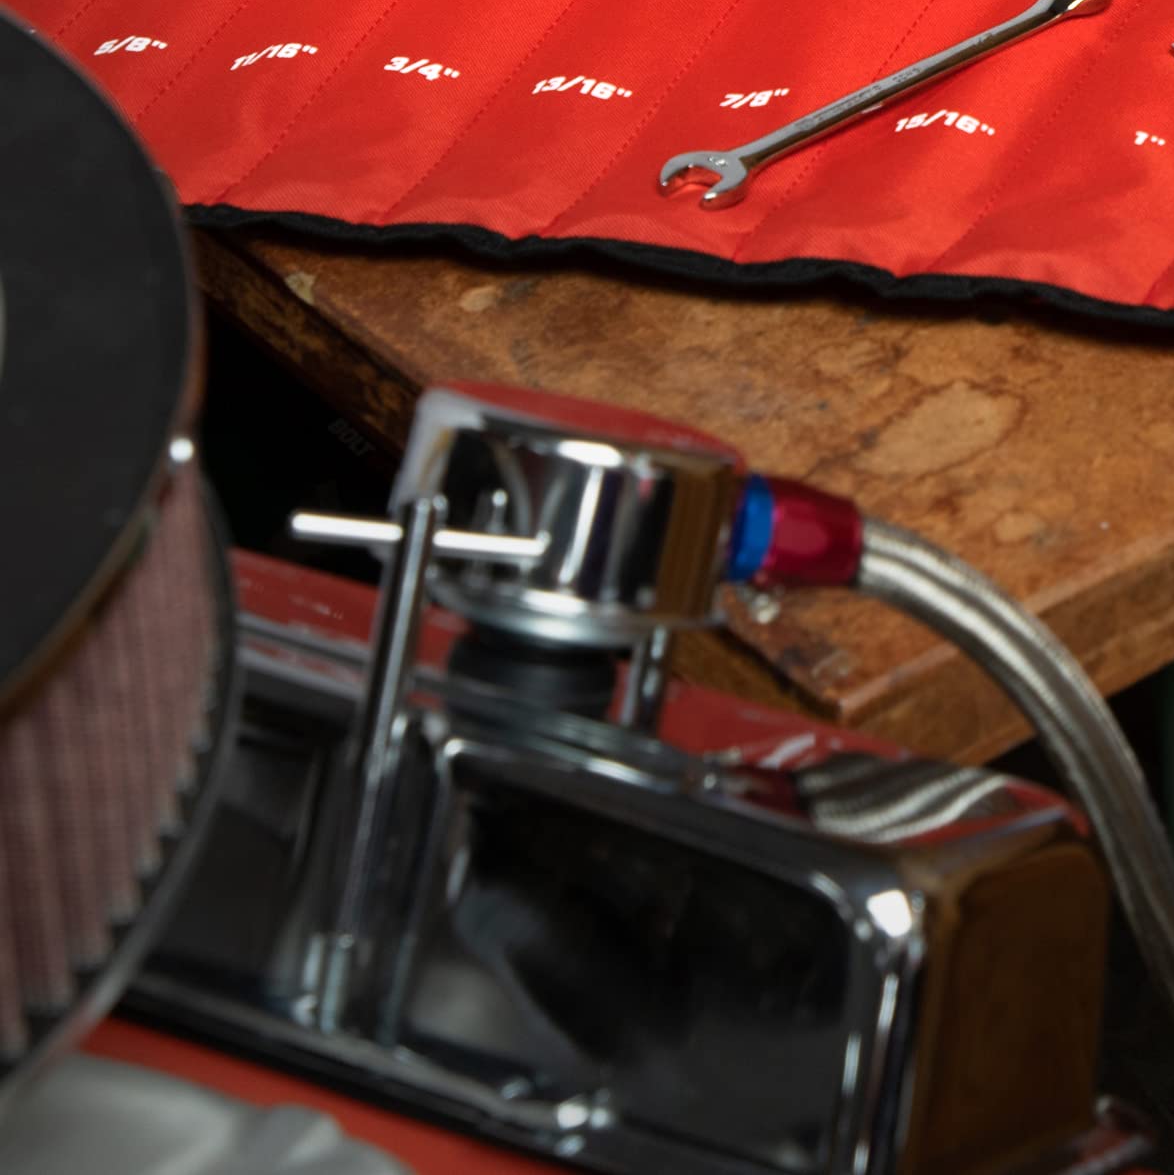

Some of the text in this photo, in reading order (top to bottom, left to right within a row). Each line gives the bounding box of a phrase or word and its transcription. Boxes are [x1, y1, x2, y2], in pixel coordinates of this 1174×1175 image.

[383, 56, 460, 81] 3/4"
[719, 88, 789, 109] 7/8"
[895, 109, 995, 136] 15/16"
